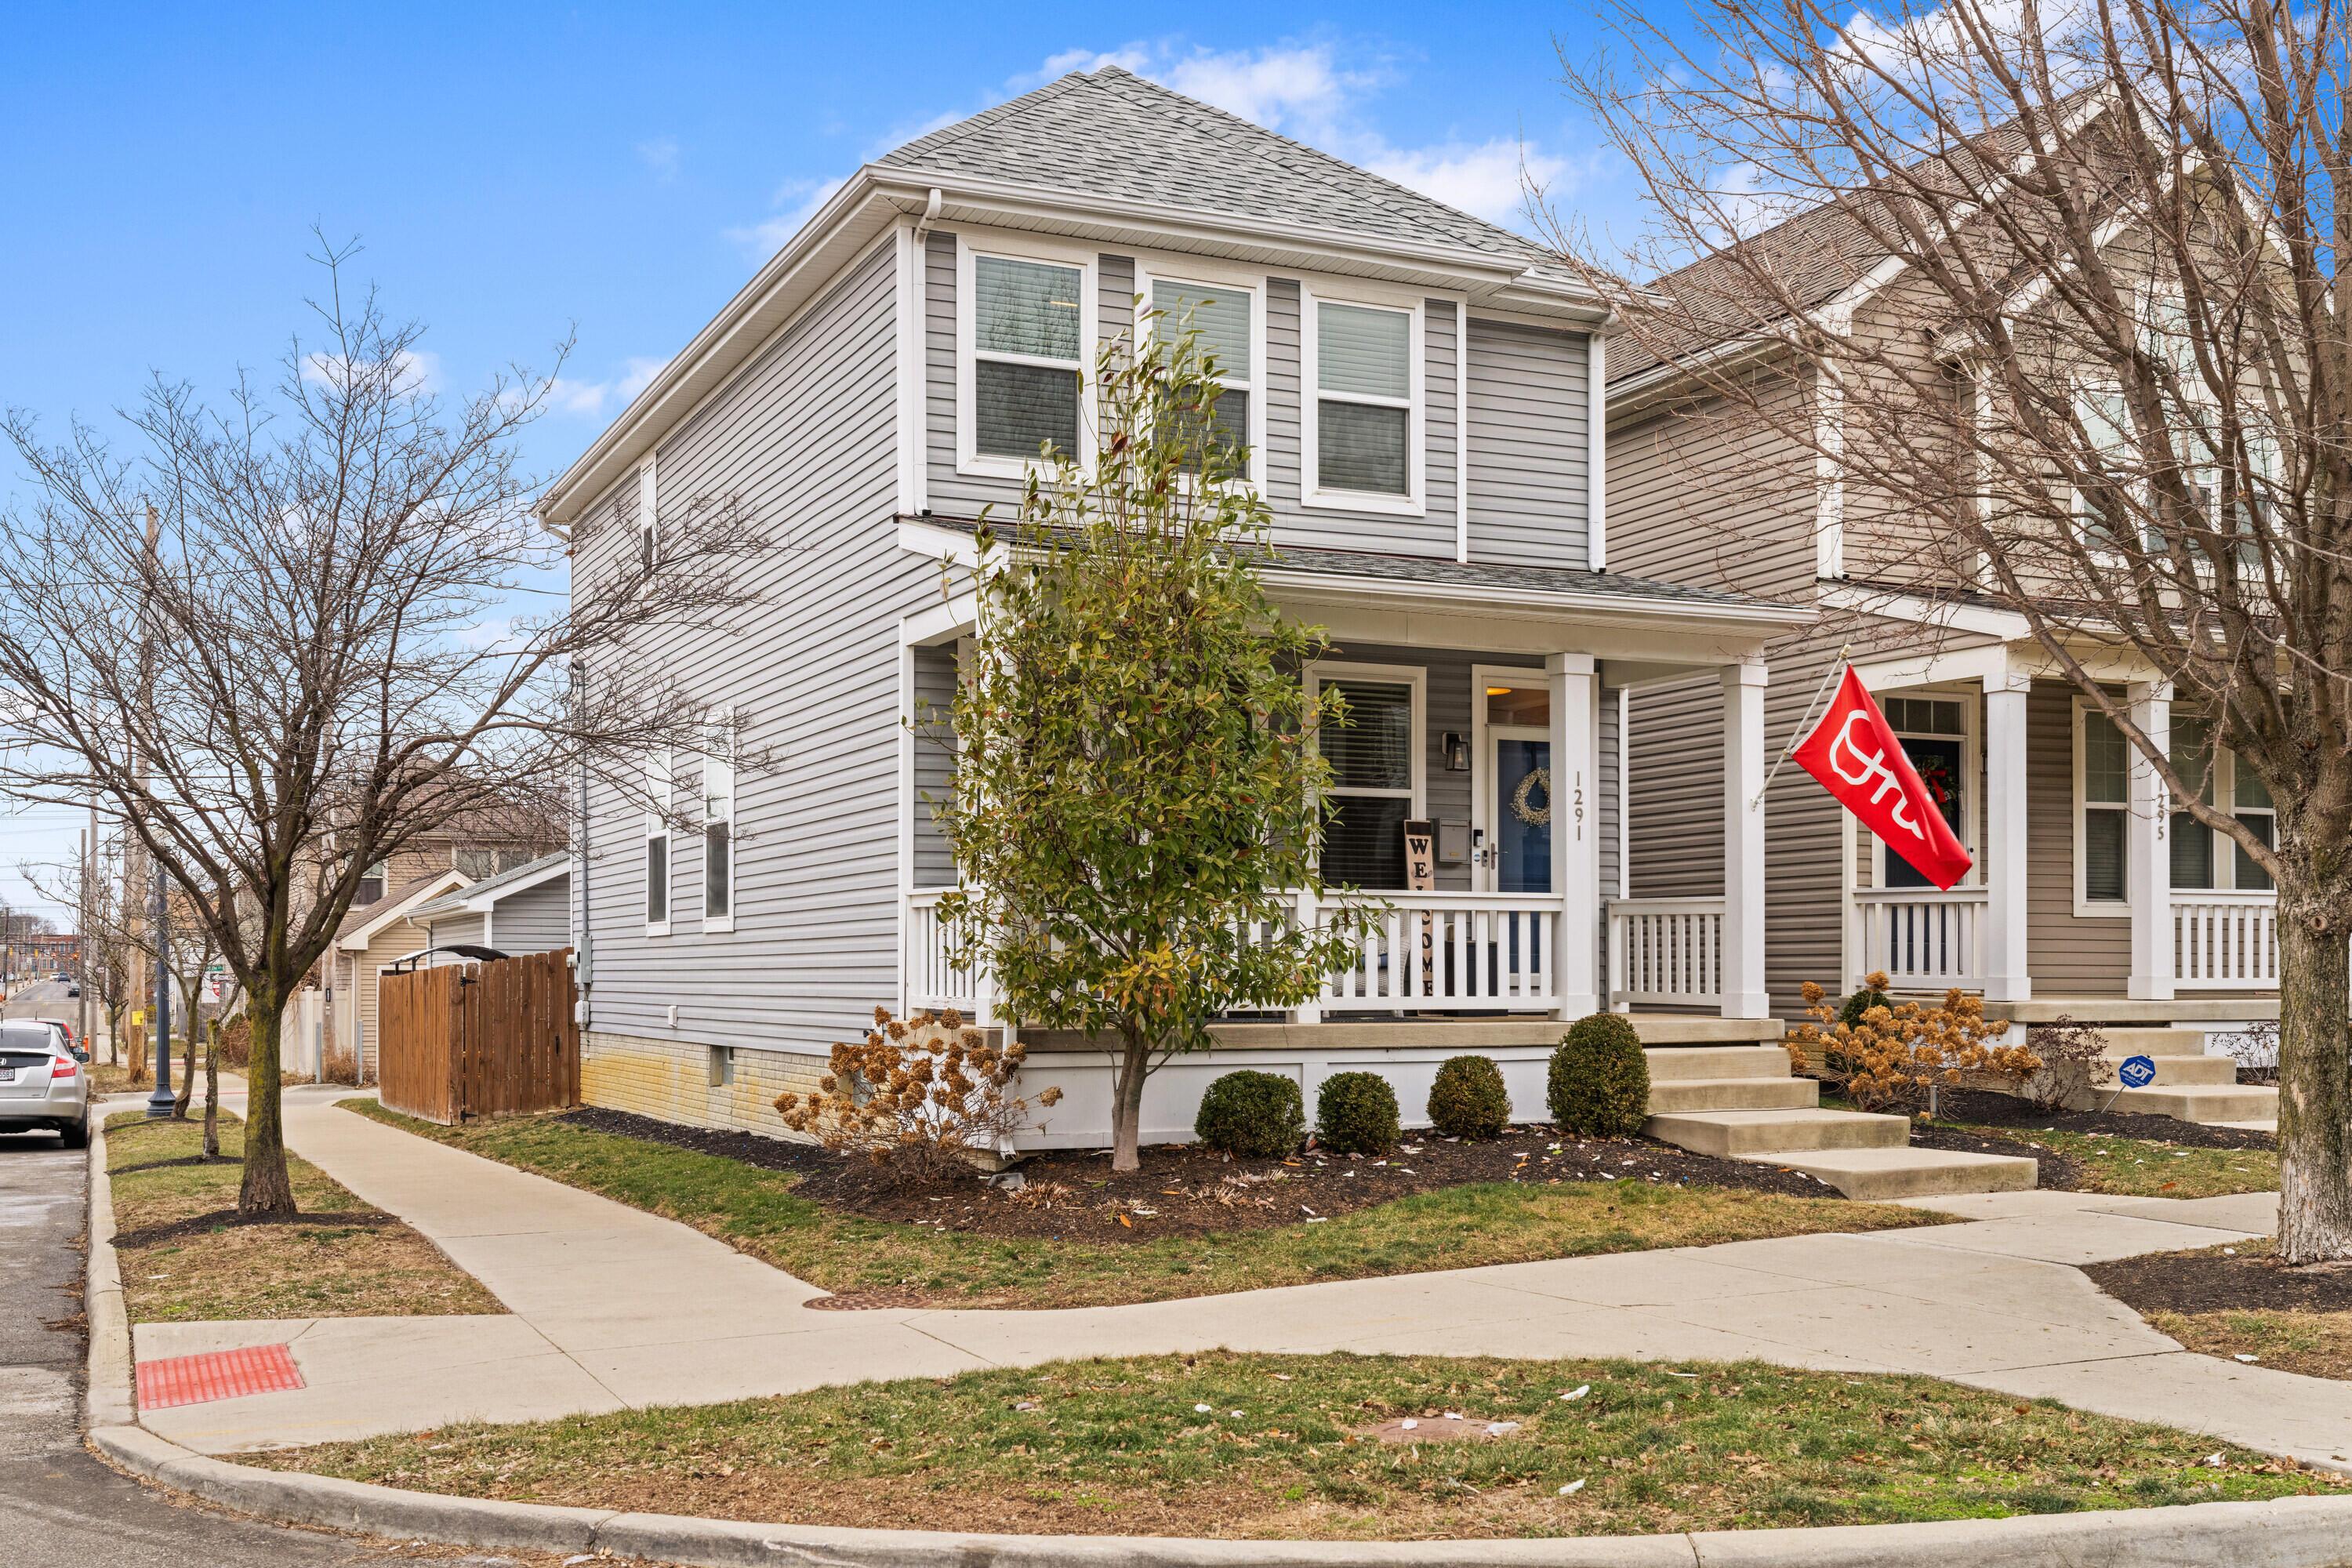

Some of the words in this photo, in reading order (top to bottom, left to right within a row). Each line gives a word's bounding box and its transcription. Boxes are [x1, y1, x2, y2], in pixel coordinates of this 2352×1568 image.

[1574, 771, 1583, 840] 1291
[1409, 838, 1433, 996] WECOME
[2123, 1062, 2154, 1080] ADT
